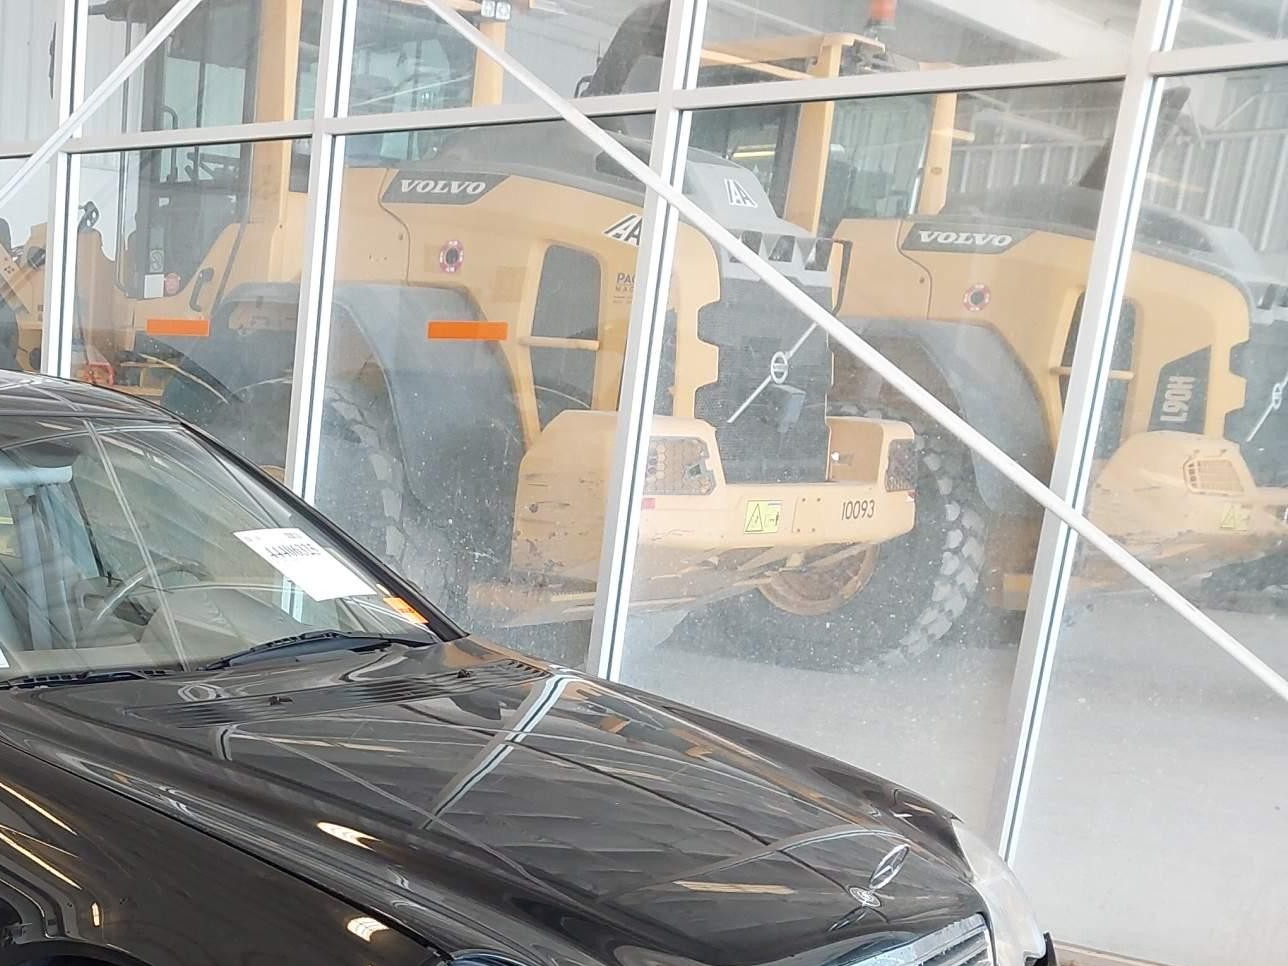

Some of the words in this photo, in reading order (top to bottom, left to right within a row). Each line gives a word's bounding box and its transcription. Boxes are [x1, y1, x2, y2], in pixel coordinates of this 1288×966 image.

[400, 178, 487, 195] VOLVO
[918, 229, 1012, 247] VOLVO
[1160, 374, 1196, 422] L90H
[841, 499, 875, 521] 10093
